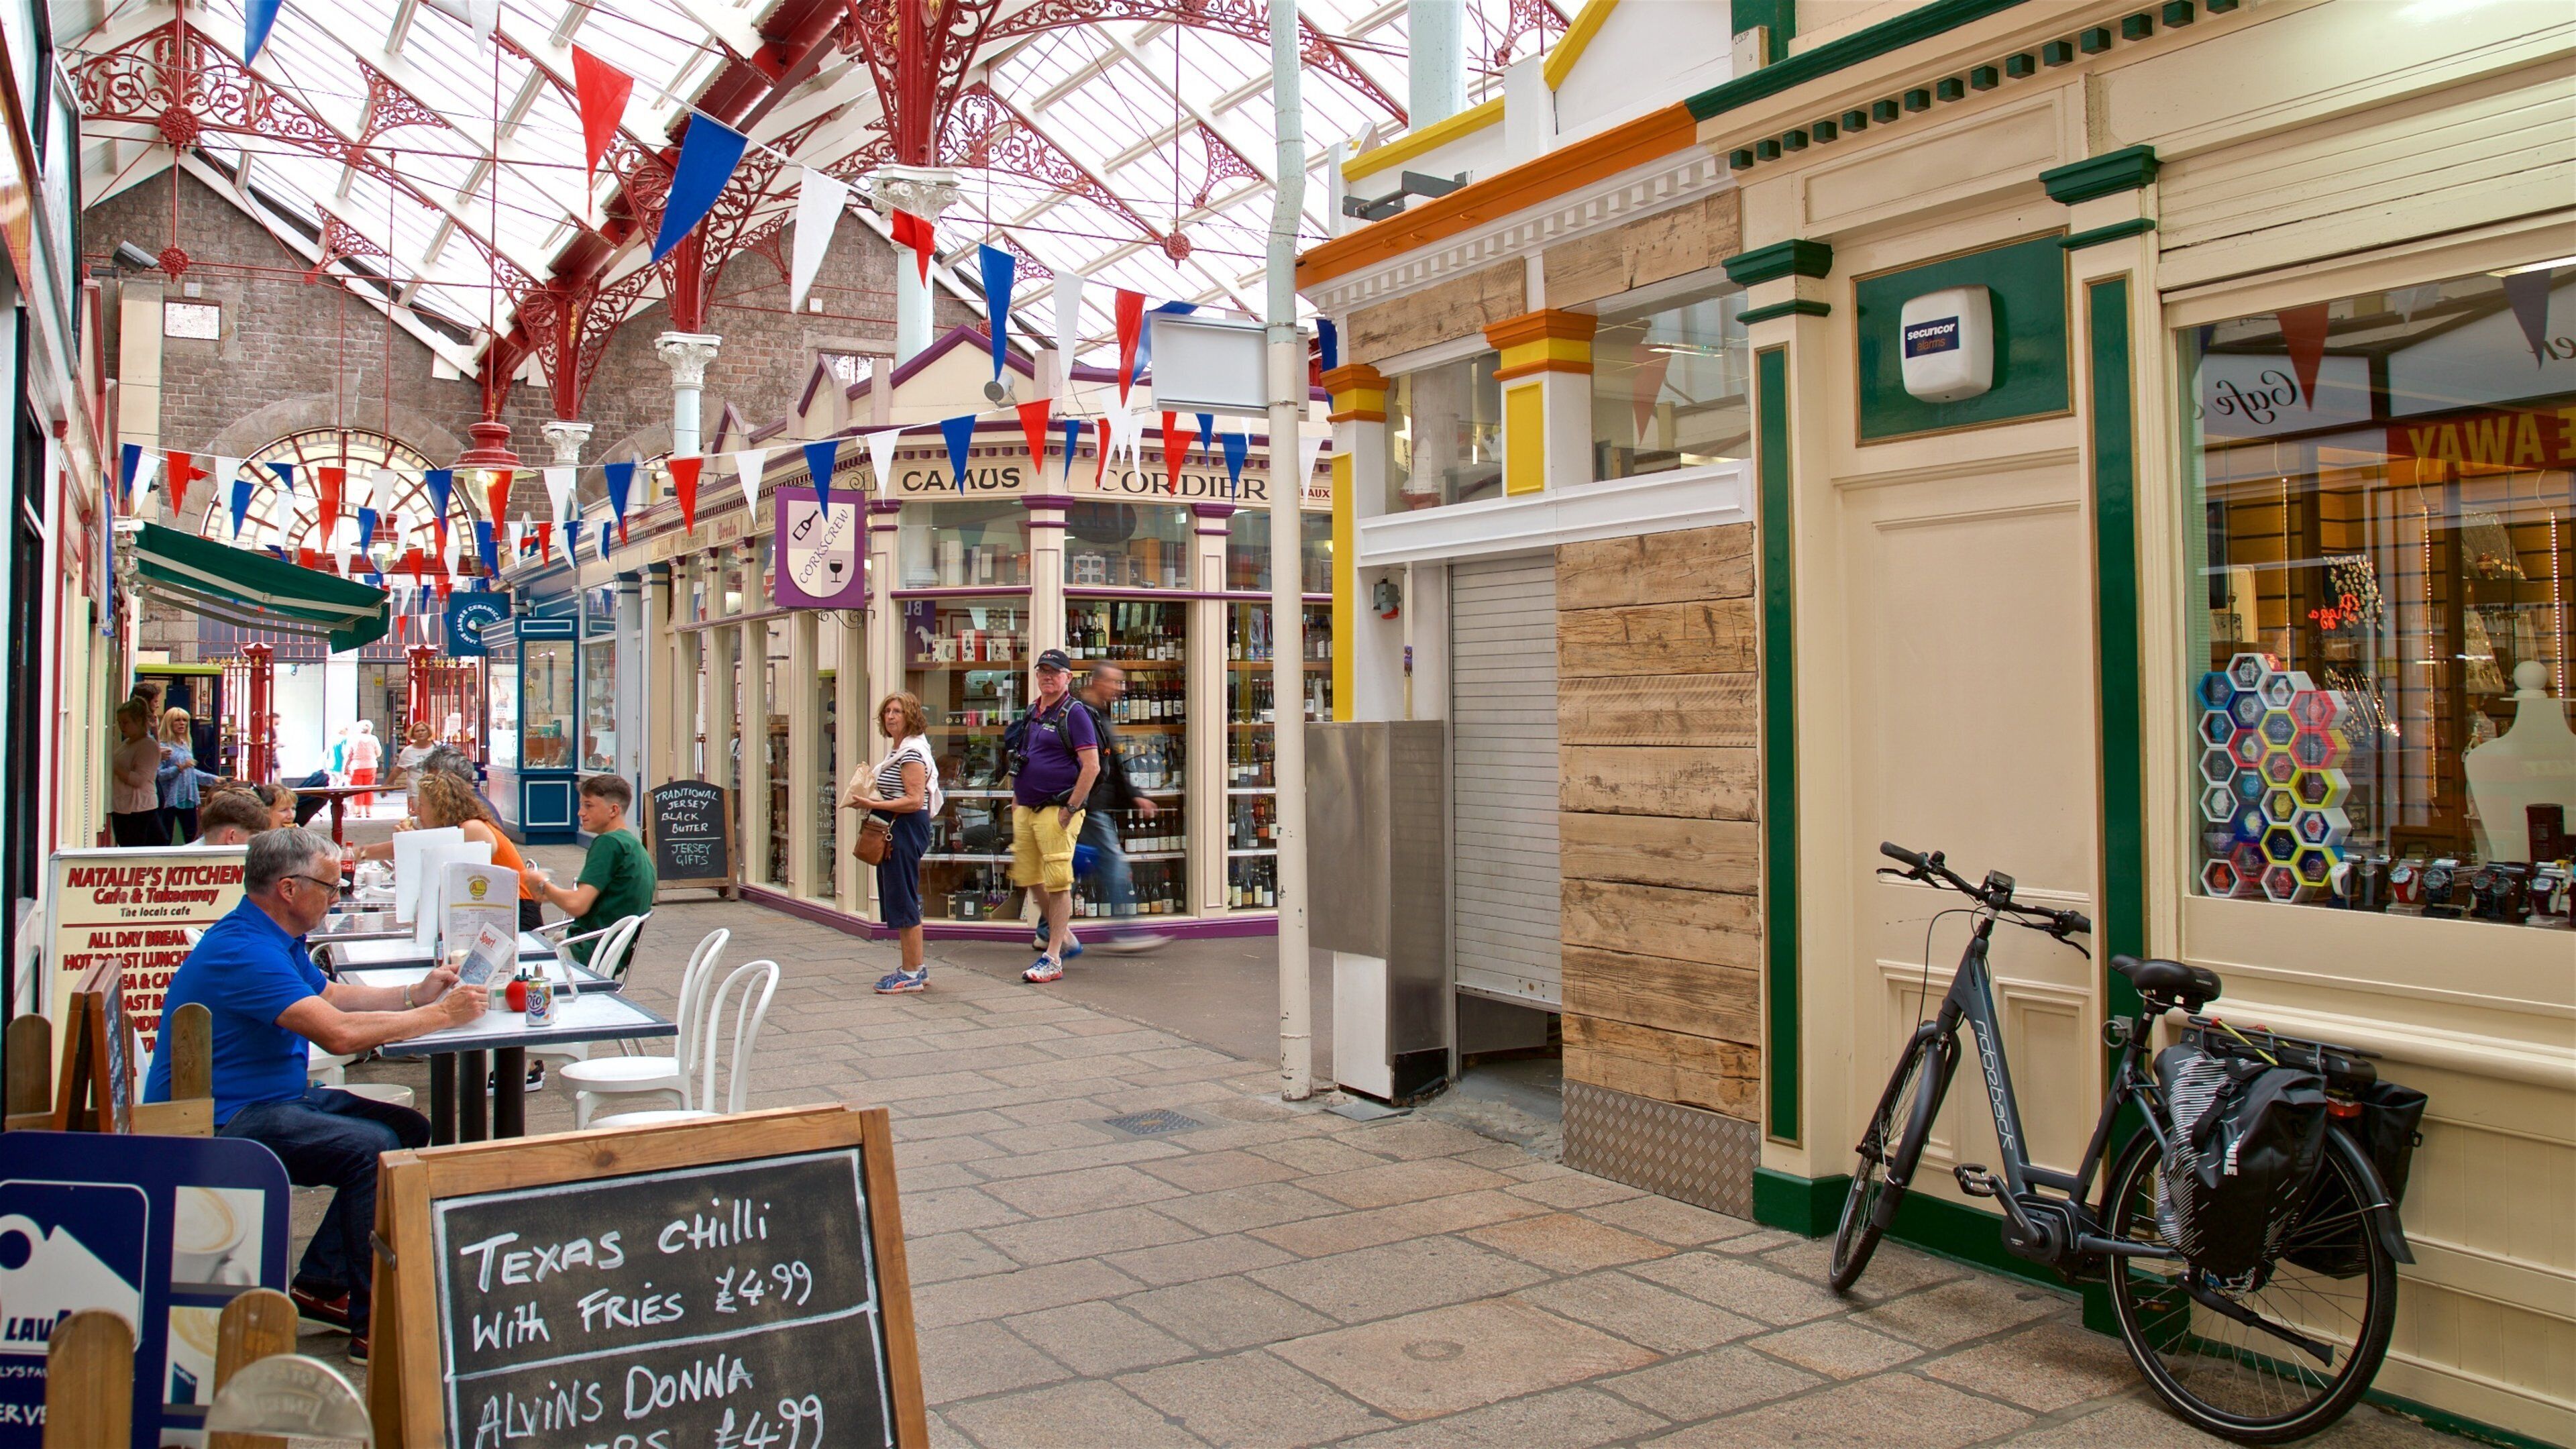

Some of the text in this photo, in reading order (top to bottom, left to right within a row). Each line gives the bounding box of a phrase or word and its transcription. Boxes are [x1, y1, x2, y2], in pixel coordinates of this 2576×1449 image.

[1907, 322, 1955, 340] securicor
[1916, 337, 1945, 352] alarms
[903, 467, 1020, 491] CAMUS
[1099, 470, 1269, 500] CORDIER
[799, 509, 848, 584] CORKSCREW
[457, 604, 502, 645] JANE JAMES CERAMICS
[655, 788, 719, 802] TRADITIONAL
[667, 800, 709, 810] JERSEY
[661, 812, 699, 821] BLACK
[671, 843, 712, 855] JERSEY
[676, 855, 708, 866] GIFTS
[67, 865, 246, 888] NATALIE'S KITCHEN
[93, 887, 219, 906] Cafe & Takeaway
[121, 906, 191, 917] The locals cafe
[87, 932, 113, 949] ALL
[115, 931, 143, 947] DAY
[480, 931, 496, 949] Sport
[62, 955, 92, 971] HOT
[140, 974, 151, 989] &
[527, 991, 542, 1007] Rio
[1975, 1019, 2014, 1150] ridgeback
[460, 1230, 625, 1292] TEXAS
[715, 1260, 812, 1313] £4.99
[625, 1353, 753, 1420] DONNA
